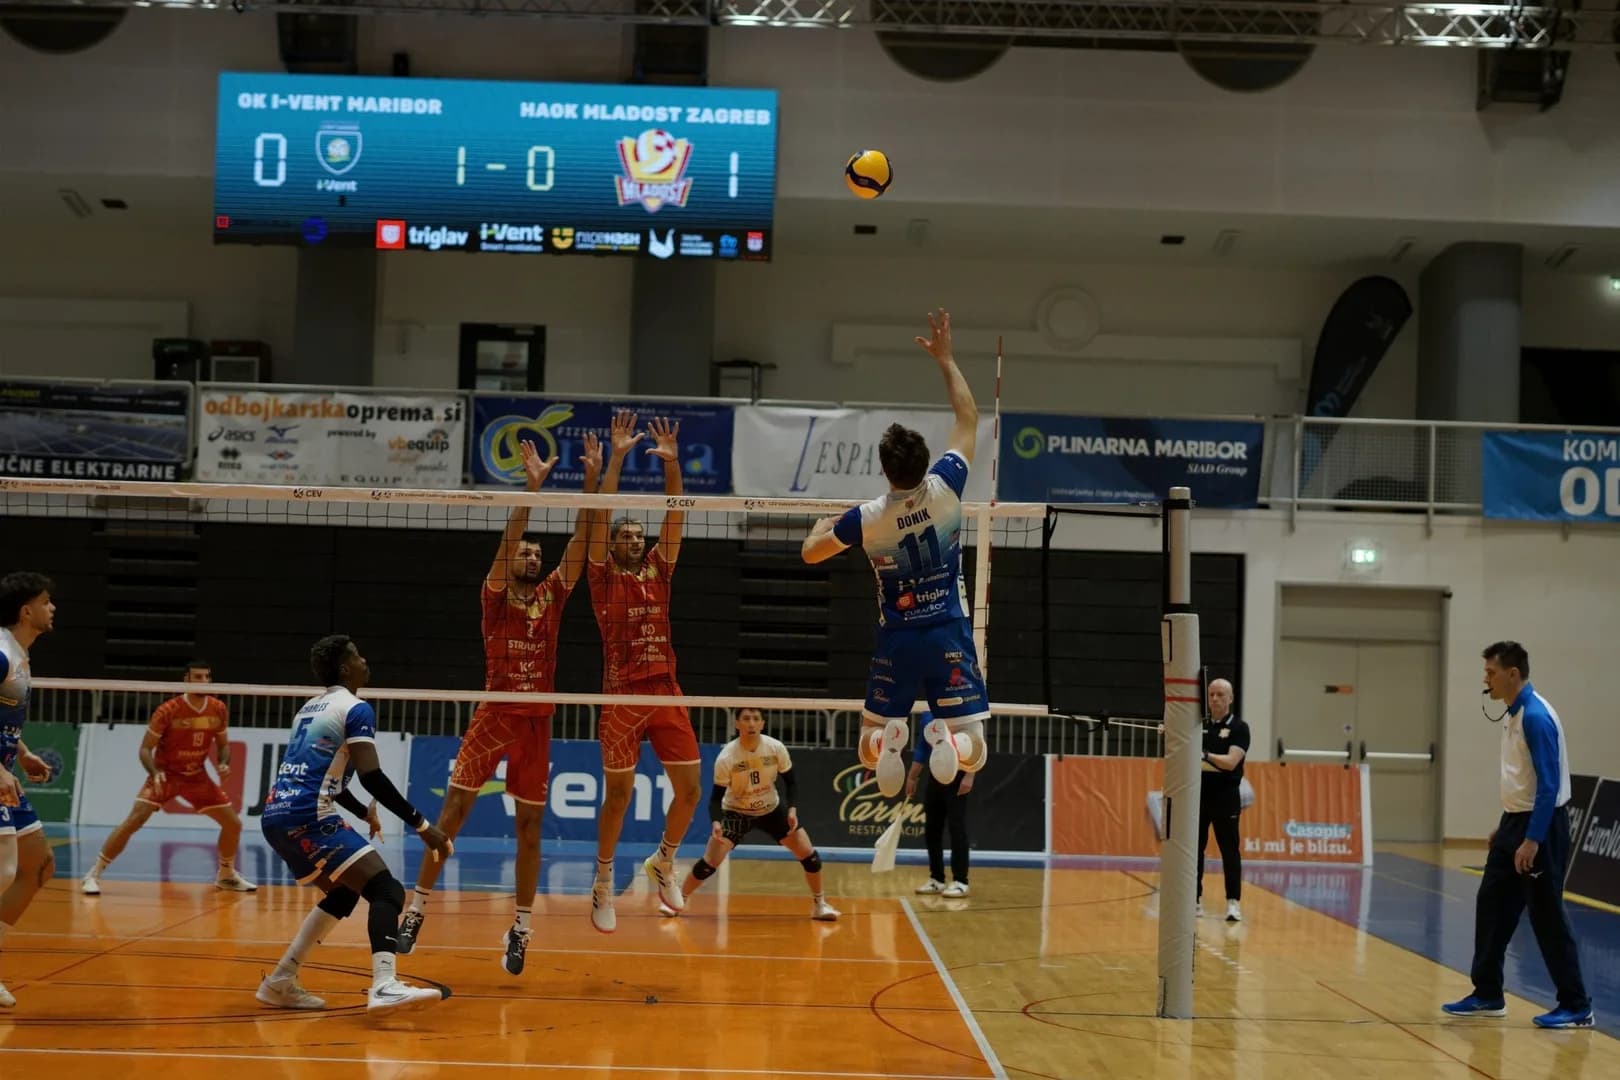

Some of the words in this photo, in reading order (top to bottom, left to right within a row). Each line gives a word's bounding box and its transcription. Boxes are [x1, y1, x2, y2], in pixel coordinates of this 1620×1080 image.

[238, 93, 267, 109] OK
[271, 94, 343, 111] I-VENT
[347, 97, 442, 114] MARIBOR
[520, 102, 578, 119] HAOK
[583, 104, 681, 122] MLADOST
[686, 107, 771, 125] ZAGREB
[253, 133, 287, 186] 0
[456, 146, 465, 185] 1
[526, 146, 555, 191] 0
[728, 151, 739, 198] 1
[408, 226, 468, 250] triglav
[204, 396, 462, 424] odbojkarskaoprema.si
[1048, 435, 1149, 456] PLINARNA
[1155, 439, 1248, 460] MARIBOR
[1563, 439, 1620, 461] KOM
[51, 459, 176, 481] ELEKTRARNE
[1217, 463, 1248, 477] Group
[305, 489, 323, 498] CEV
[679, 499, 696, 508] CEV
[897, 508, 931, 529] DONIK
[898, 525, 942, 573] 11
[749, 770, 760, 785] 18
[1286, 819, 1352, 839] Časopis,
[1244, 838, 1259, 851] ki
[1264, 841, 1285, 853] mi
[1290, 841, 1305, 856] je
[1307, 840, 1352, 855] blizu.
